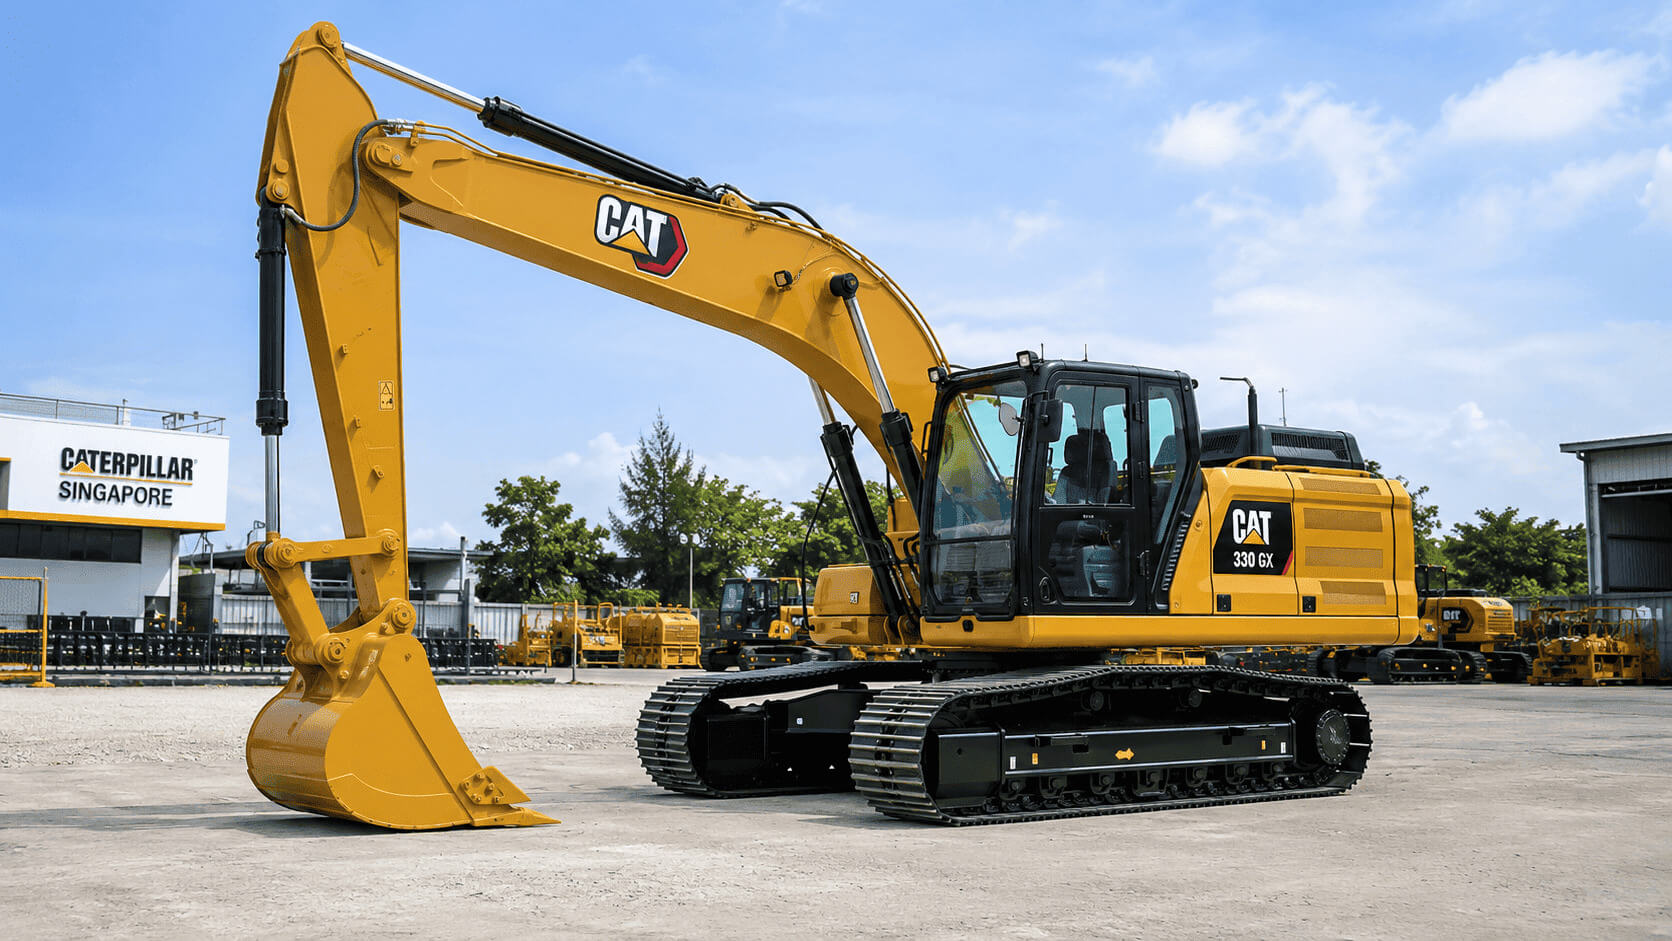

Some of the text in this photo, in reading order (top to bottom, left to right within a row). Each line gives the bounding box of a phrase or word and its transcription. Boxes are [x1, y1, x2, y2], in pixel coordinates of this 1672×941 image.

[596, 196, 668, 258] CAT
[61, 447, 193, 480] CATERPILLAR
[59, 481, 173, 506] SINGAPORE
[1232, 508, 1271, 545] CAT
[1233, 551, 1274, 568] 330 GX
